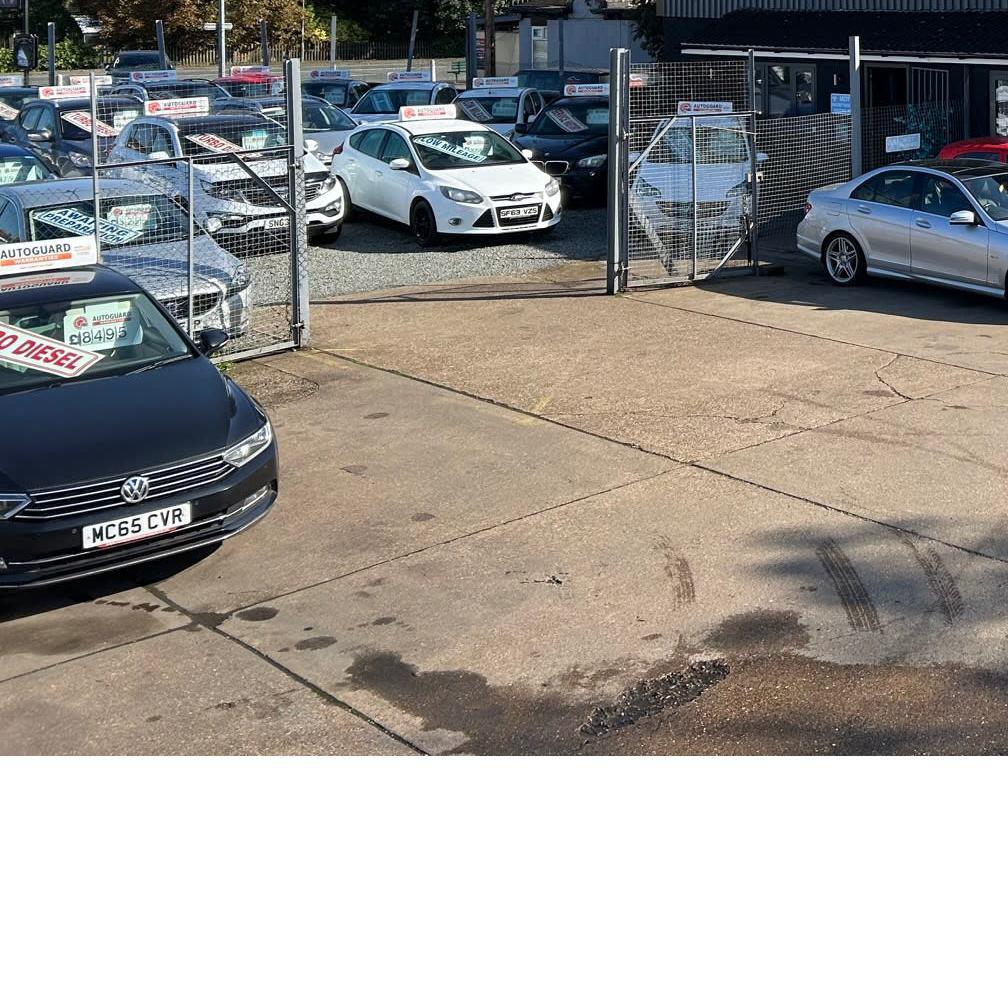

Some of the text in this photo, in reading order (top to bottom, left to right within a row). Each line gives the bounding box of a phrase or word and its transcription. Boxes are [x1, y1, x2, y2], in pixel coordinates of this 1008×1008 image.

[419, 136, 481, 161] LOW MILEAGE
[60, 209, 129, 237] AWAIING
[1, 243, 71, 259] AUTOGUARD
[13, 339, 83, 370] DIESEL
[92, 508, 184, 543] MC65 CVR
